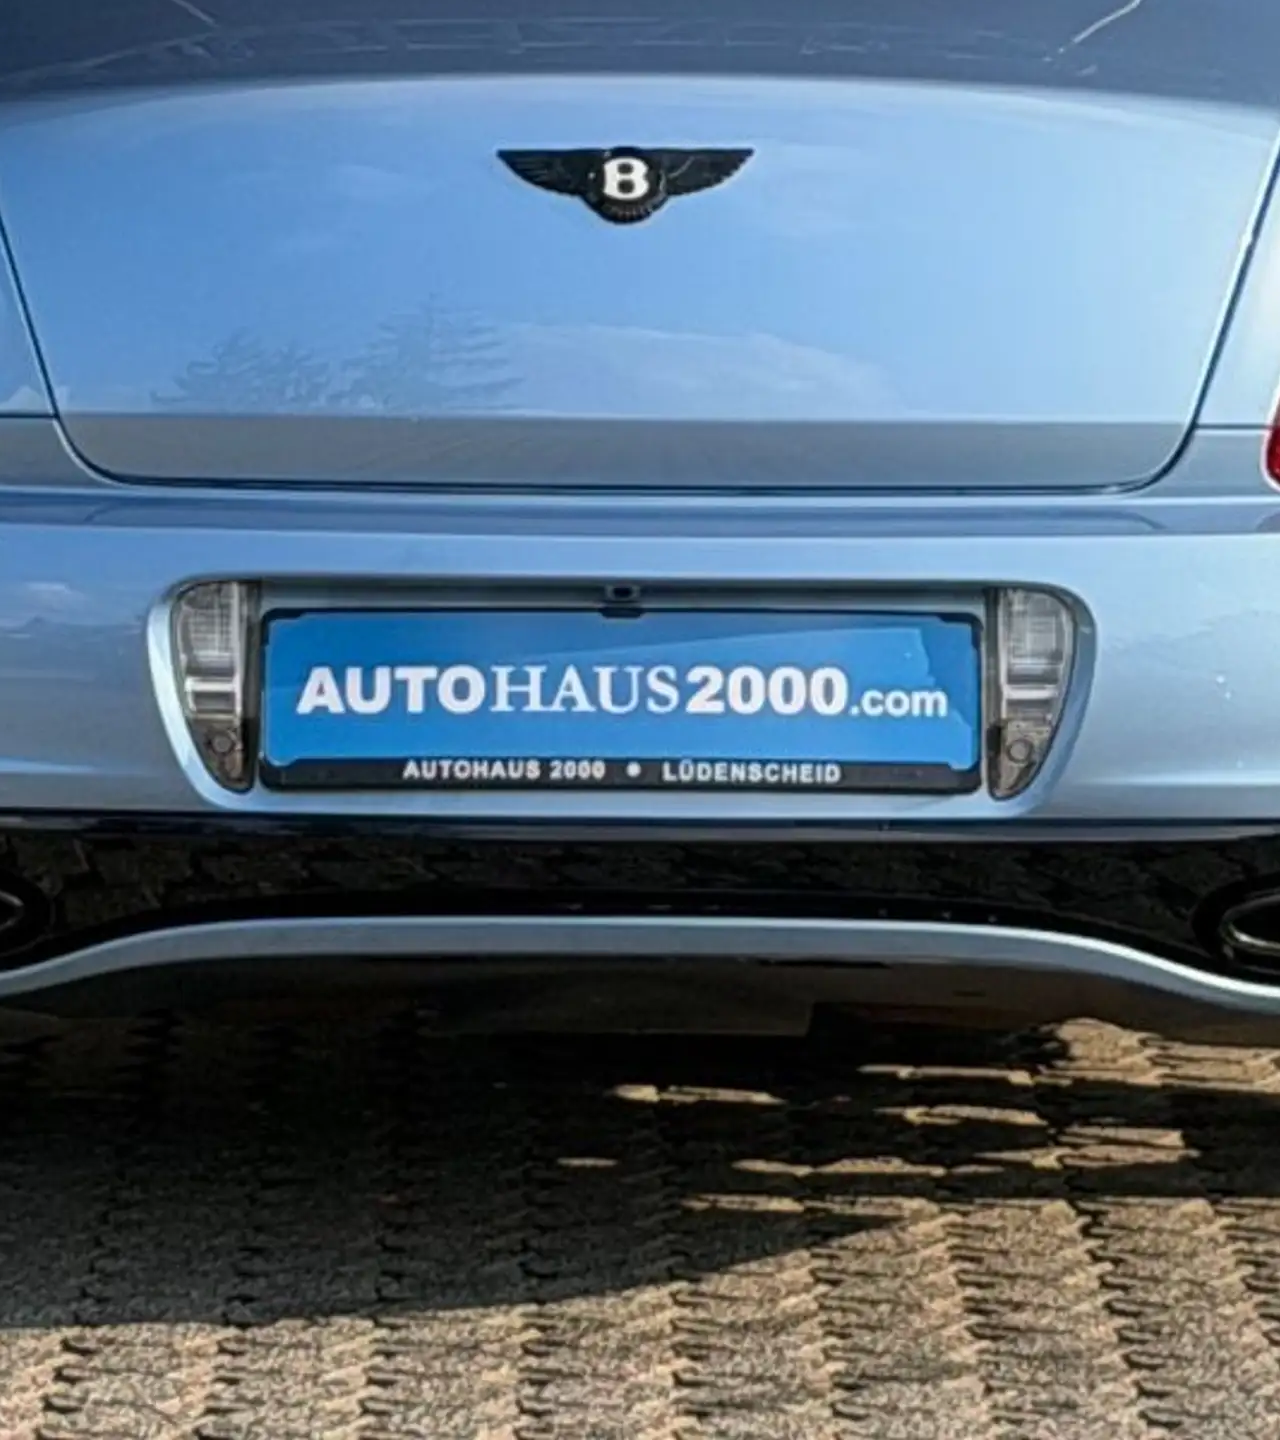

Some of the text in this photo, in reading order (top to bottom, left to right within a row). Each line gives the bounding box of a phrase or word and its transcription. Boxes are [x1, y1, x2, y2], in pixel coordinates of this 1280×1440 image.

[296, 664, 949, 717] AUTOHAUS2000.com
[402, 758, 841, 784] AUTOHAUS 2000 LÜDENSCHEID
